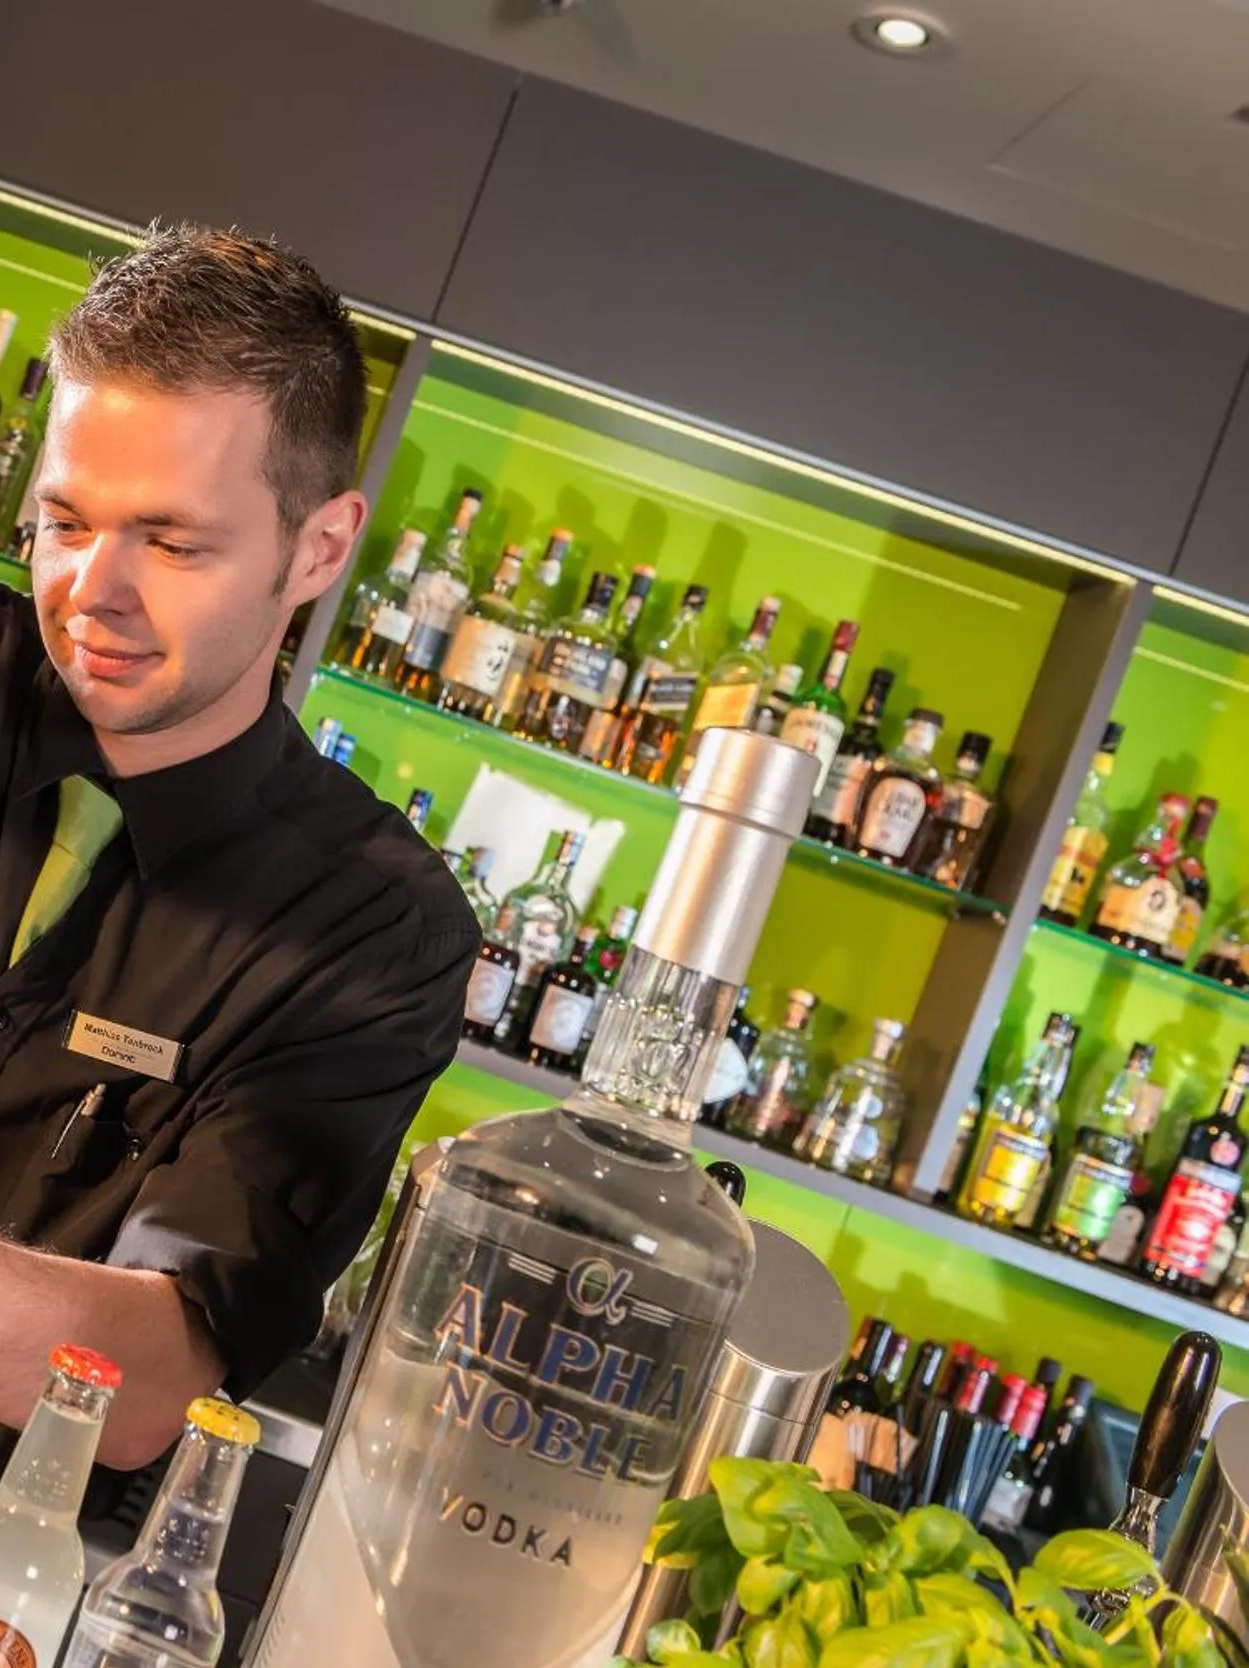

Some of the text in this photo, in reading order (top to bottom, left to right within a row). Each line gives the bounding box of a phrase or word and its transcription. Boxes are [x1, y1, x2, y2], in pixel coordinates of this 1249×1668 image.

[434, 1282, 688, 1422] ALPHA
[432, 1361, 662, 1485] NOBLE
[438, 1487, 574, 1567] VODKA
